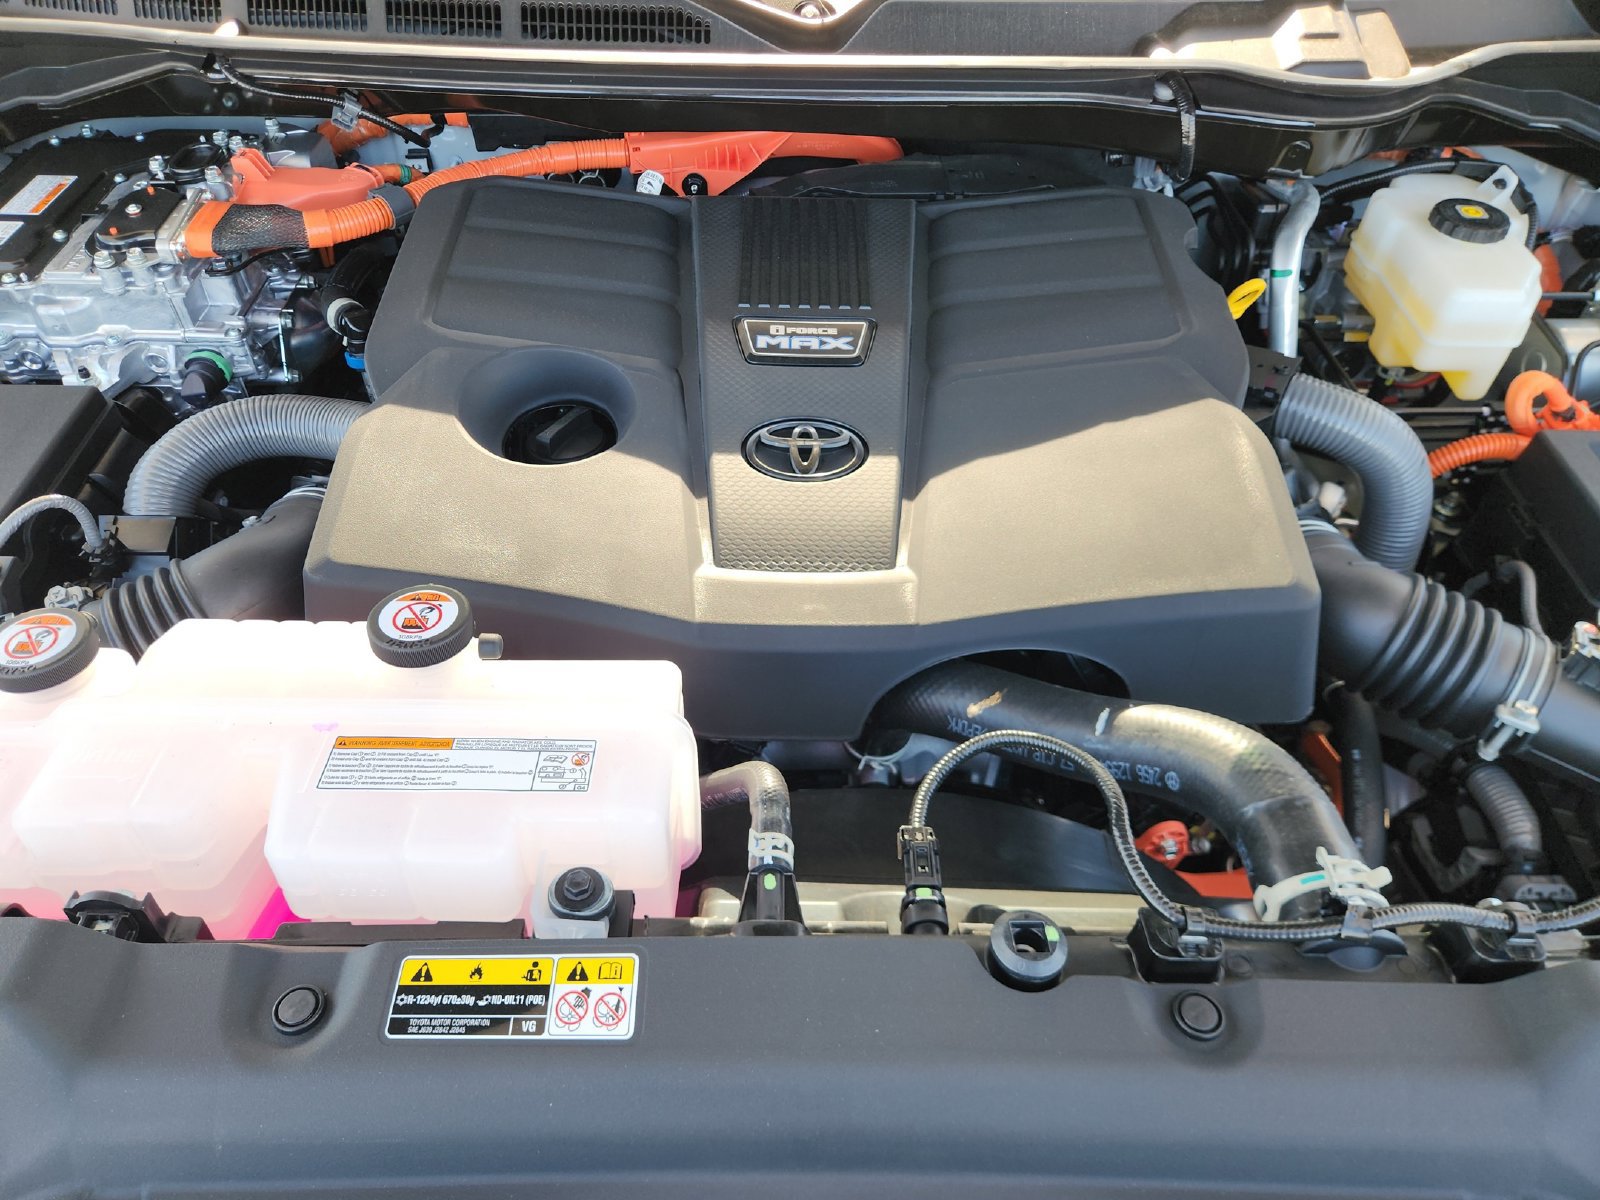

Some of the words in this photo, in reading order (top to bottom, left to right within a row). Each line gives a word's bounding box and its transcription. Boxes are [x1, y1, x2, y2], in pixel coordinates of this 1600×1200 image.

[756, 335, 855, 350] MAX
[525, 994, 546, 1007] (POE)
[409, 1018, 430, 1026] TOYOTA
[431, 1018, 451, 1026] MOTOR
[451, 1018, 490, 1027] CORPORATION
